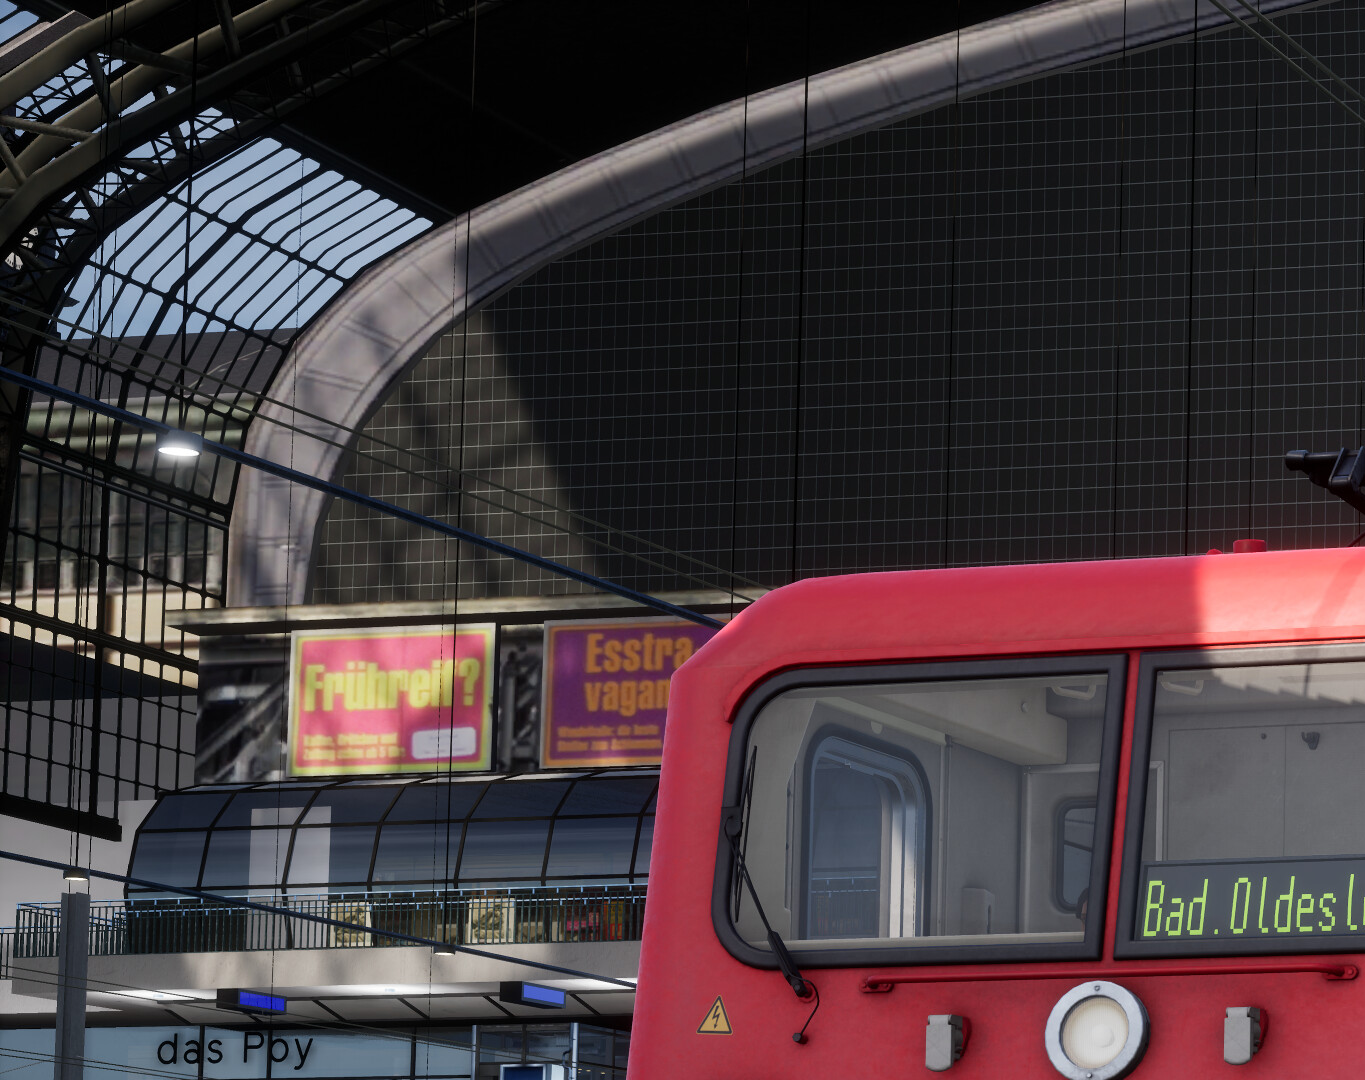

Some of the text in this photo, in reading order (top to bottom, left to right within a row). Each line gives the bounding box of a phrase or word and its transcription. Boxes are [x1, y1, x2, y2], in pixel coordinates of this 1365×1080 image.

[303, 656, 482, 713] Frühreif?
[584, 678, 671, 717] vagan
[157, 1033, 223, 1065] das
